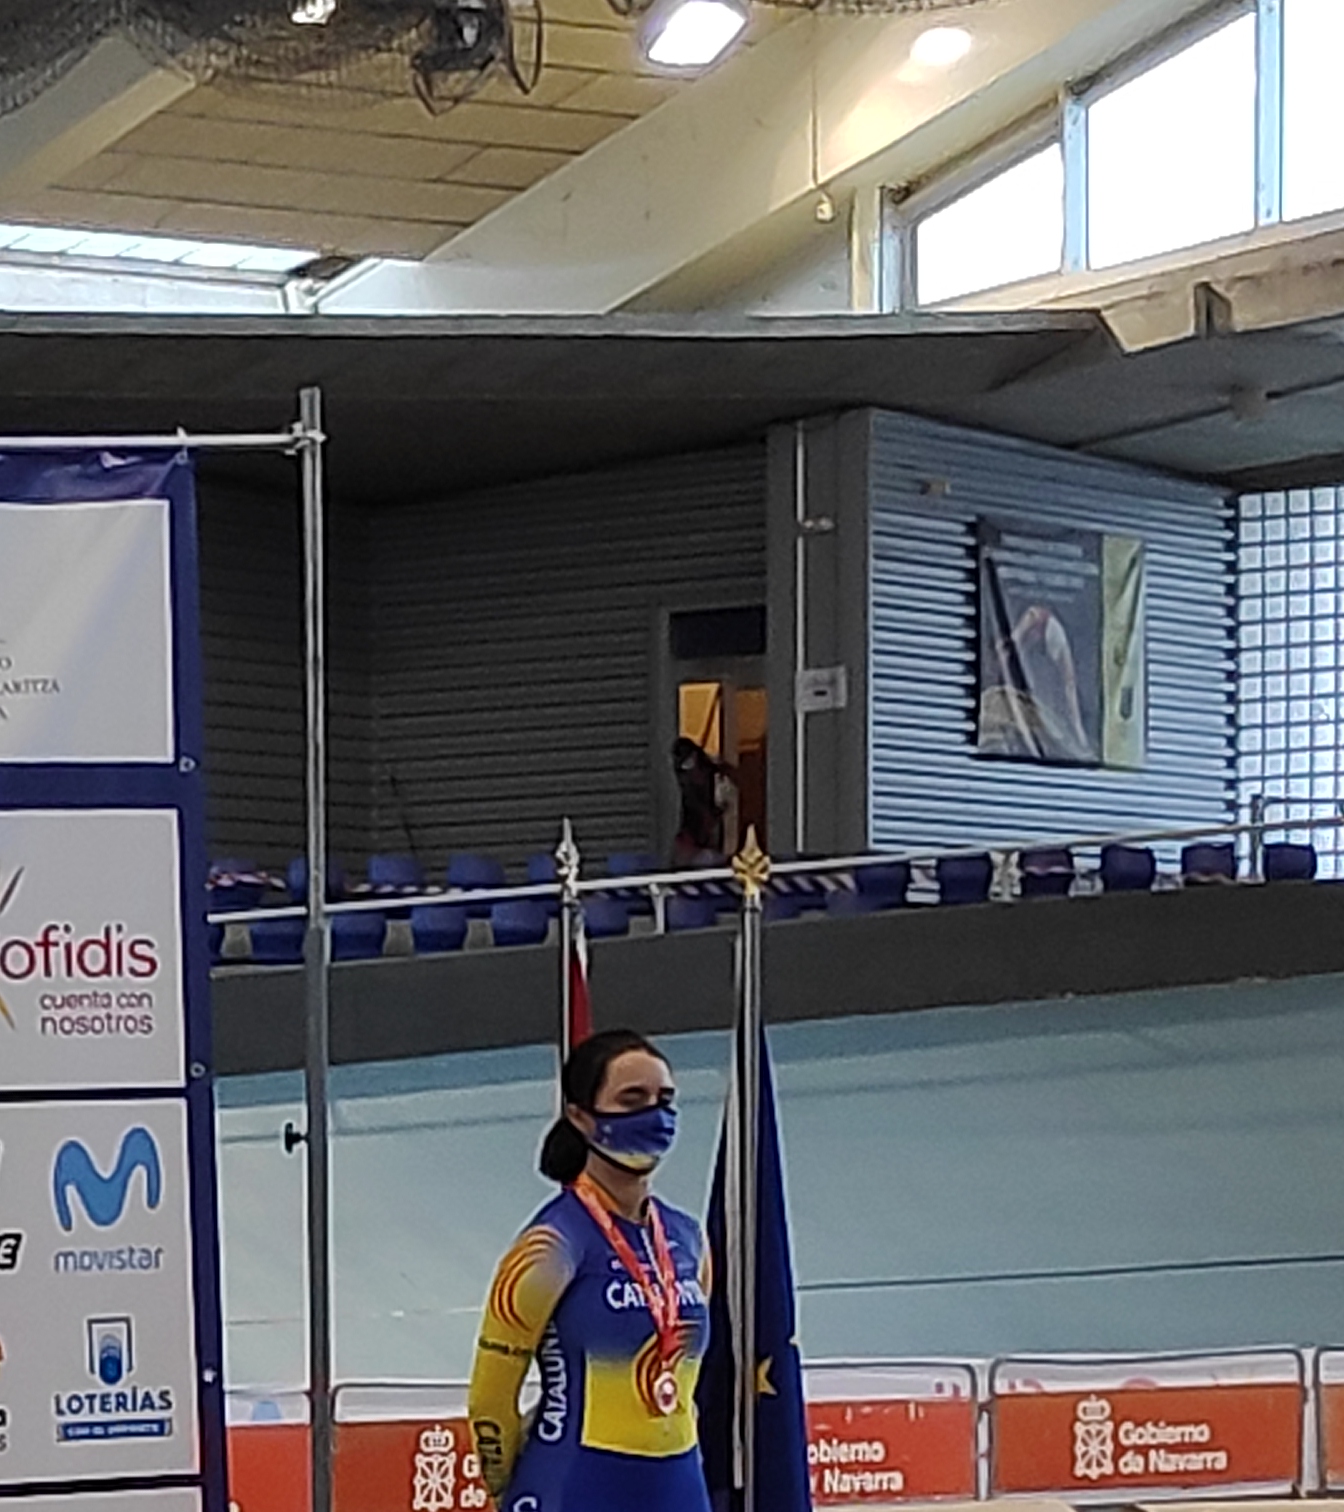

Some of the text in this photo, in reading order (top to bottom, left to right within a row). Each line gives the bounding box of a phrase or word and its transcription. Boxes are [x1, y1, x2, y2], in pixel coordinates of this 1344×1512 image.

[39, 991, 154, 1011] cuenta con
[40, 1012, 154, 1036] nosotros
[54, 1246, 165, 1274] movistar
[54, 1385, 173, 1416] LOTERÍAS
[1118, 1420, 1211, 1448] Gobierno
[808, 1439, 885, 1465] obierno
[1118, 1448, 1228, 1474] de Navarra
[824, 1467, 904, 1494] Navarra
